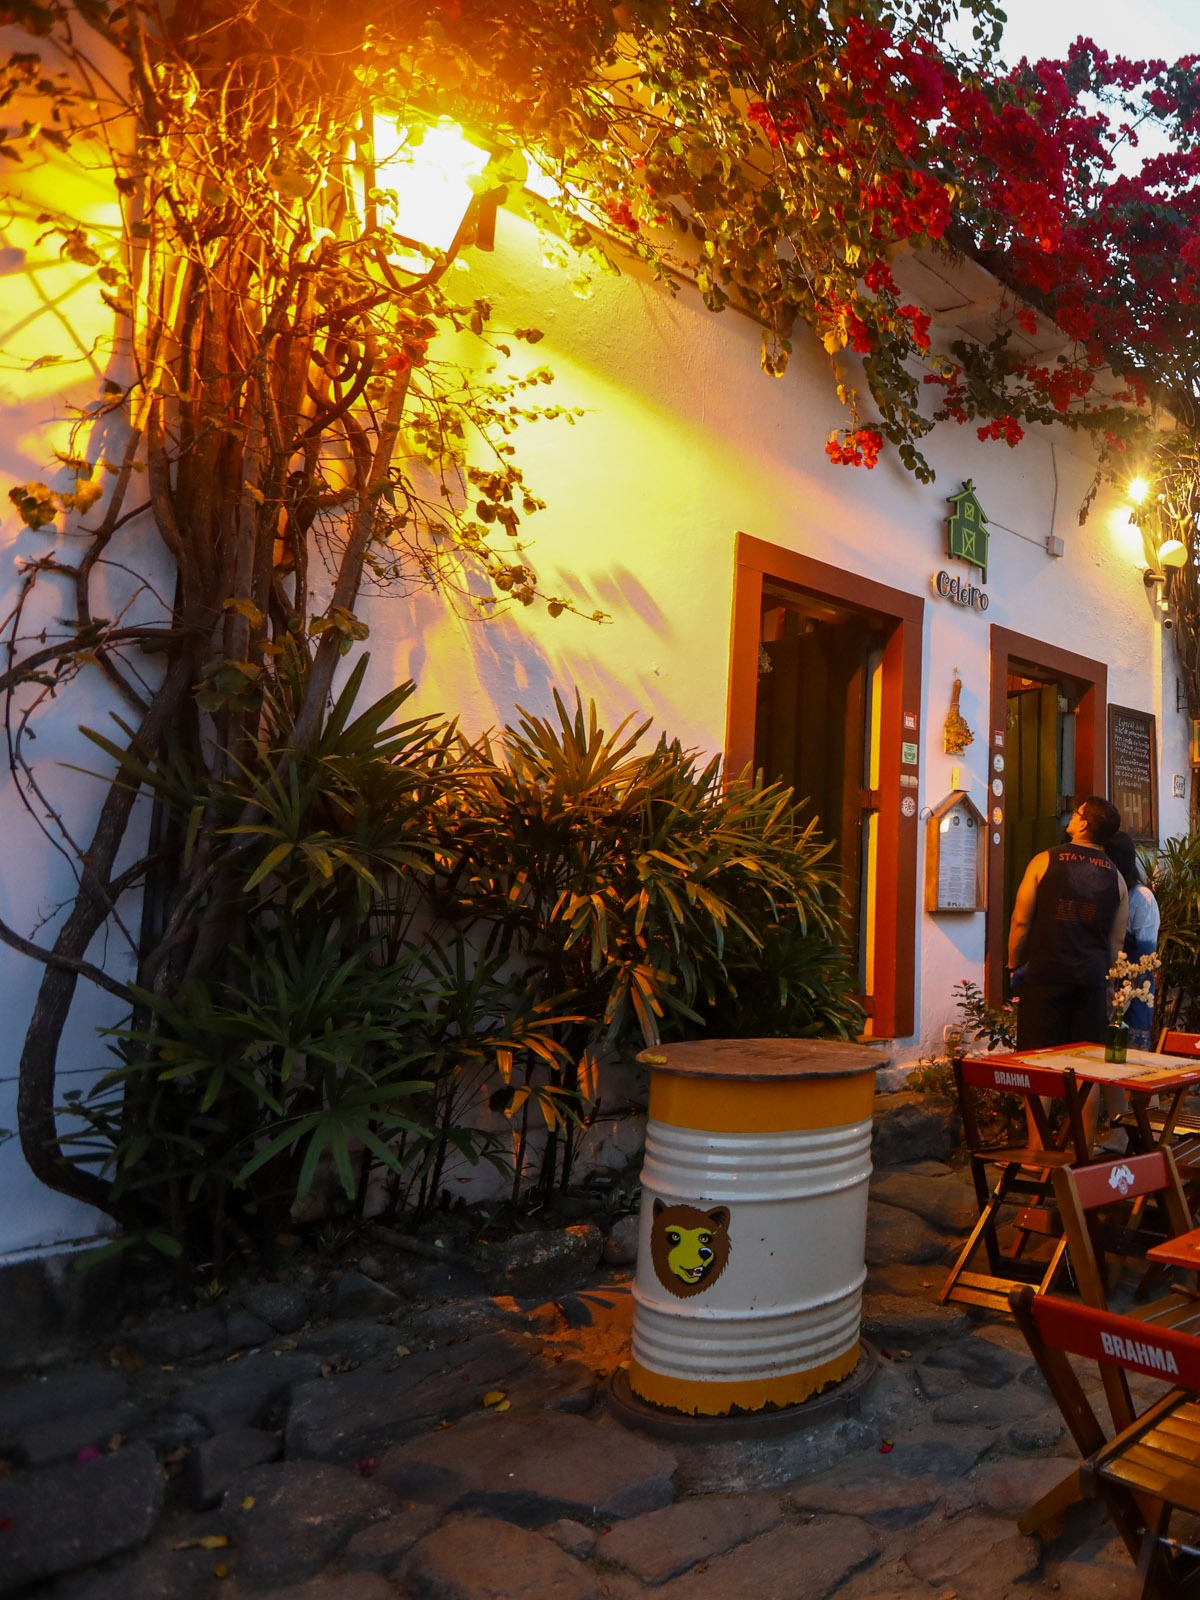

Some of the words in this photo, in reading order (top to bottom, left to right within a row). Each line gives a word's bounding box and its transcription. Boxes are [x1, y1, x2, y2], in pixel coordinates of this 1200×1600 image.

[935, 570, 989, 611] Celeiro
[1059, 853, 1085, 862] STAY
[1089, 856, 1113, 870] WILD
[994, 1070, 1031, 1089] BRAHMA
[1100, 1331, 1180, 1376] BRAHMA
